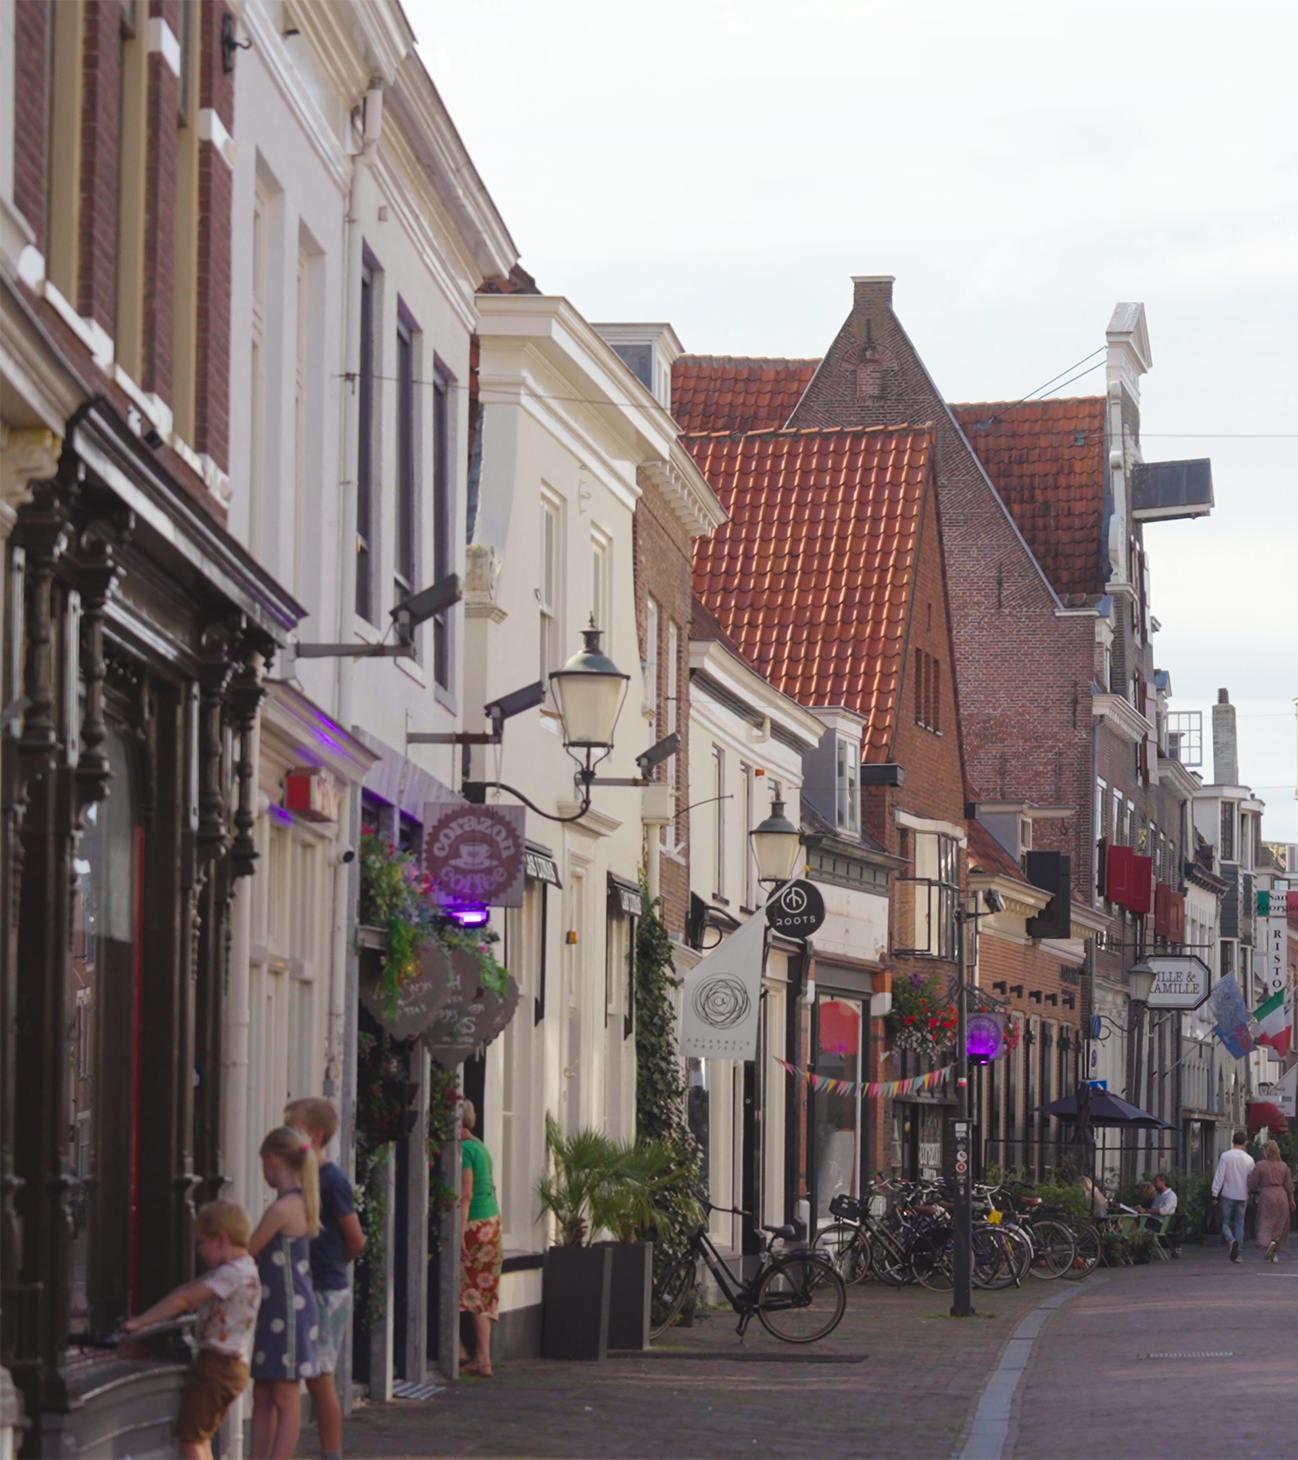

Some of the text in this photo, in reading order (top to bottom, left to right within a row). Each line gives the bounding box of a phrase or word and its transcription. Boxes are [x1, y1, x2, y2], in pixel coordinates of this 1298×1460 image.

[433, 815, 516, 858] corazon
[440, 866, 507, 894] coffee
[1268, 893, 1288, 901] San
[776, 915, 816, 926] ROOTS
[1272, 930, 1282, 994] RISTO
[1156, 971, 1197, 983] ILLE &
[1149, 983, 1200, 994] AMILLE
[687, 1037, 750, 1046] ARIADNE'S
